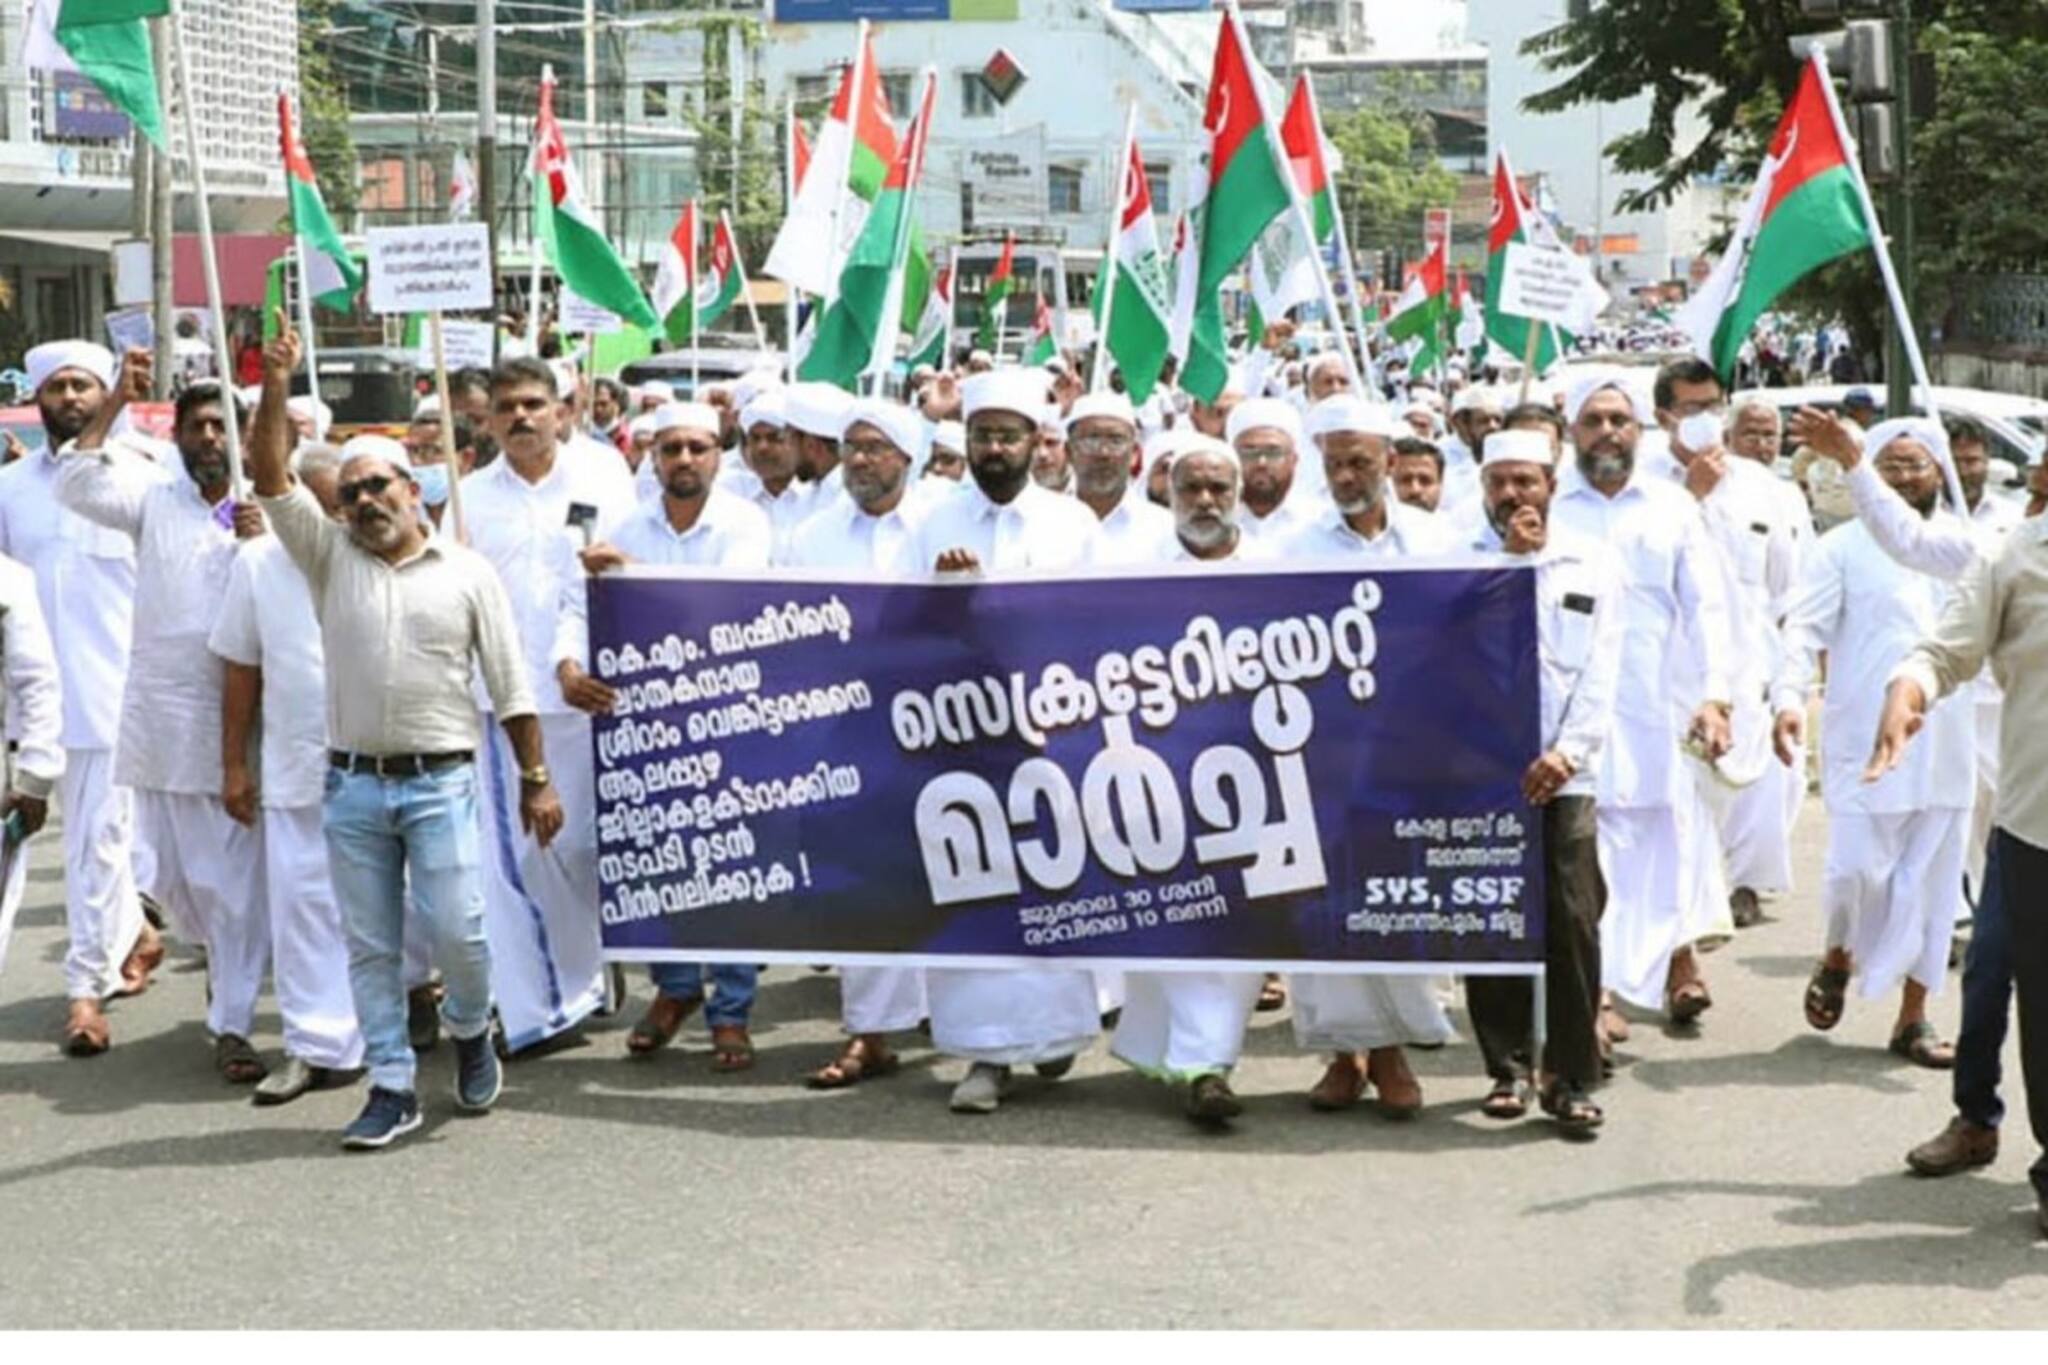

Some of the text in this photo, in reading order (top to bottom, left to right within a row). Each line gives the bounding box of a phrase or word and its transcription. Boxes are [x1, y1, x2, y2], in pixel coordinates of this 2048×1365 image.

[598, 751, 722, 804] ആലപ്പുഴ
[914, 684, 1328, 905] മാർച്ച്
[599, 833, 687, 883] നടപടി
[1124, 889, 1151, 908] 30
[1158, 874, 1217, 902] ശനി
[1365, 877, 1525, 910] SYS, SSF
[1024, 895, 1229, 945] രാവിലെ 10 മണി
